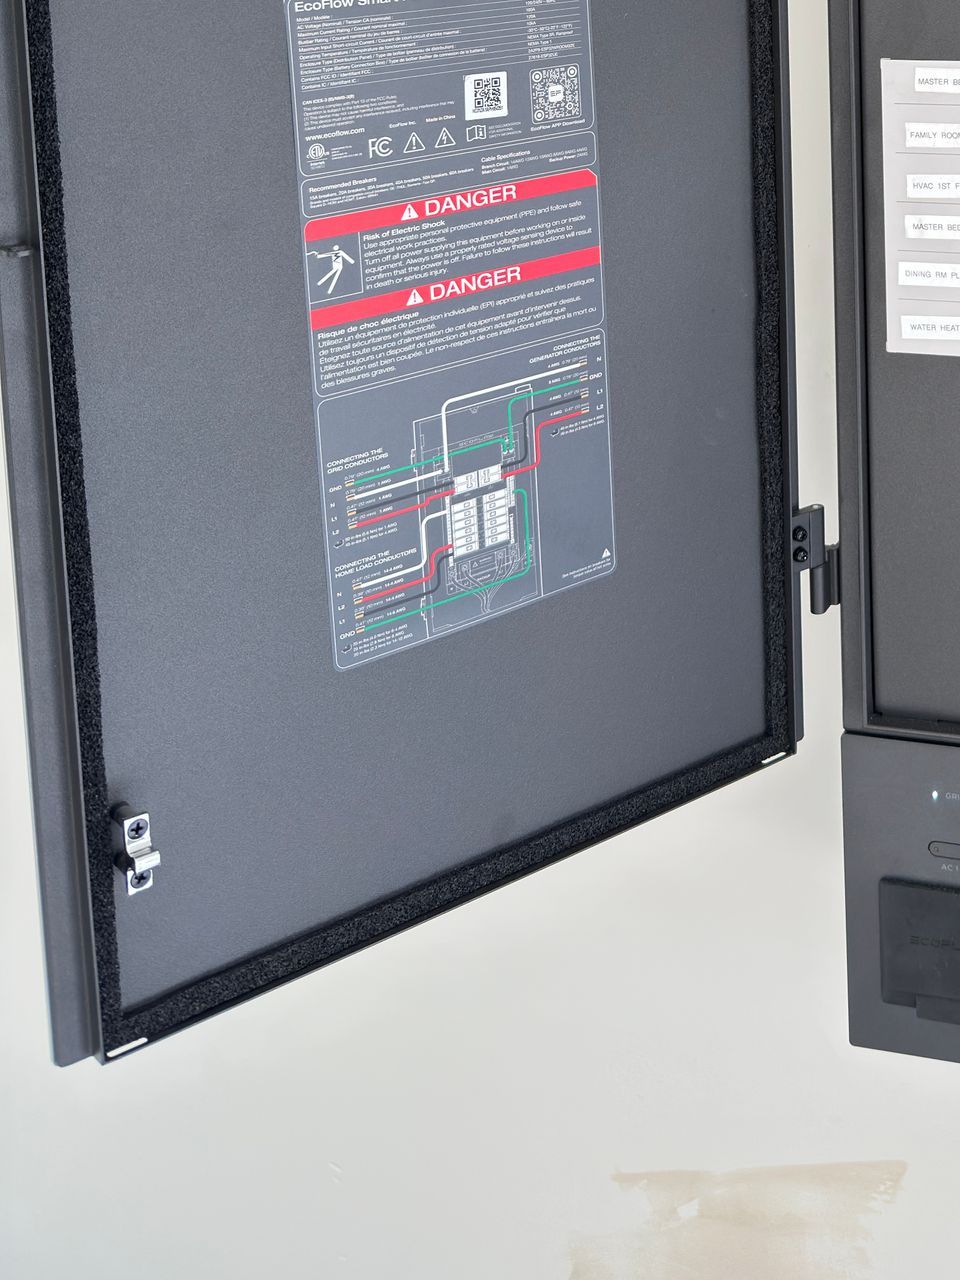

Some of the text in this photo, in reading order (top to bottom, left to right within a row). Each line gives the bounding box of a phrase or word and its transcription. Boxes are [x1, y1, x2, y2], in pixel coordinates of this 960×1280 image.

[918, 78, 949, 86] MASTER
[305, 127, 365, 141] www.ecoflow.com
[910, 131, 937, 139] FAMILY
[481, 150, 530, 163] Cable Specifications
[309, 177, 377, 193] Recommended Breakers
[912, 182, 934, 190] HVAC
[424, 185, 516, 216] DANGER
[362, 219, 446, 241] Risk of Electric Shock
[912, 223, 944, 231] MASTER
[430, 266, 522, 301] DANGER
[317, 328, 345, 339] Risque
[359, 320, 379, 330] choc
[380, 311, 419, 325] électrique
[910, 324, 937, 332] WATER
[553, 337, 589, 351] CONNECTING
[529, 340, 601, 364] GENERATOR CONDUCTORS
[589, 372, 602, 380] GND
[327, 451, 369, 468] CONNECTING
[327, 452, 388, 474] GRID CONDUCTORS
[329, 485, 343, 493] GND
[334, 550, 390, 572] CONNECTING THE
[335, 548, 417, 578] HOME LOAD CONDUCTORS
[340, 630, 356, 640] GND
[941, 863, 953, 871] AC
